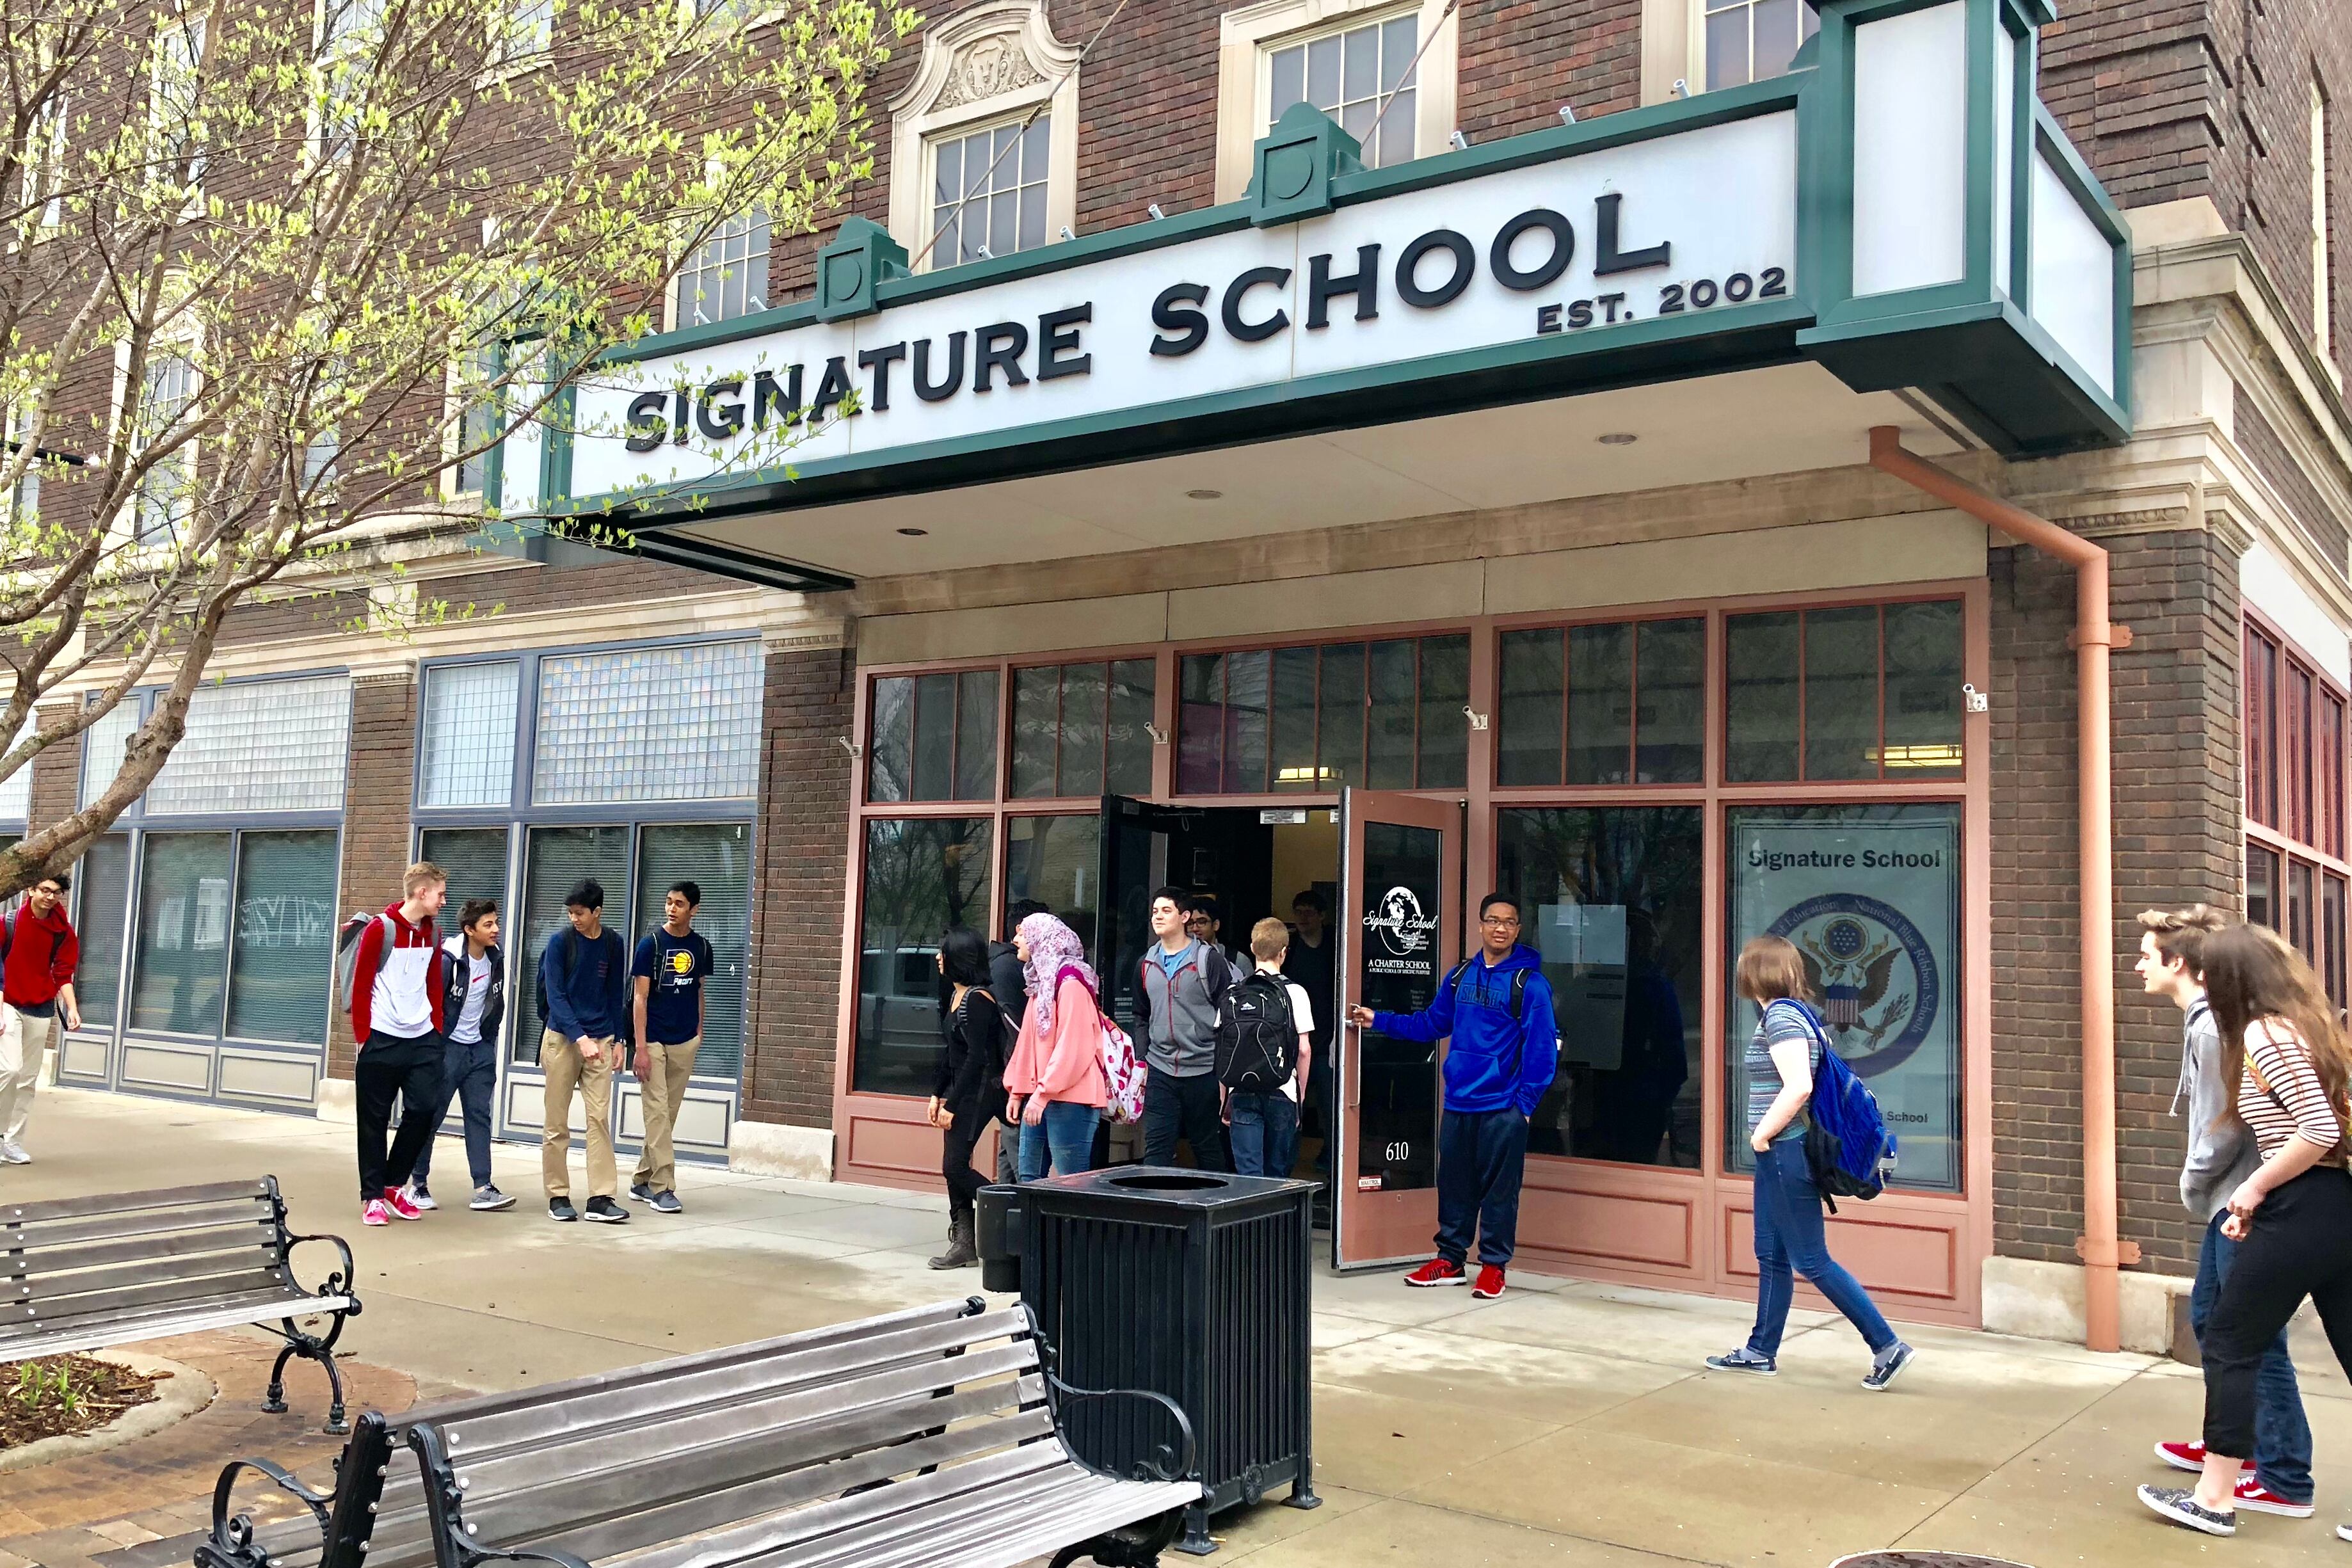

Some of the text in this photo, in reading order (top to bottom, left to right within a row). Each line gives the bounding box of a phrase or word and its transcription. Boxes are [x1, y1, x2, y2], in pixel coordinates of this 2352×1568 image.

[1537, 266, 1787, 333] EST. 2002
[625, 193, 1671, 452] SIGNATURE SCHOOL
[1748, 849, 1940, 871] Signature School
[1363, 910, 1438, 932] Signature School
[1784, 898, 1839, 927] Education
[1374, 959, 1405, 968] CHARTER
[1405, 961, 1432, 970] SCHOOL
[1856, 899, 1933, 1034] National Blue Ribbon Schools
[1887, 1111, 1928, 1123] School
[1386, 1141, 1409, 1162] 610
